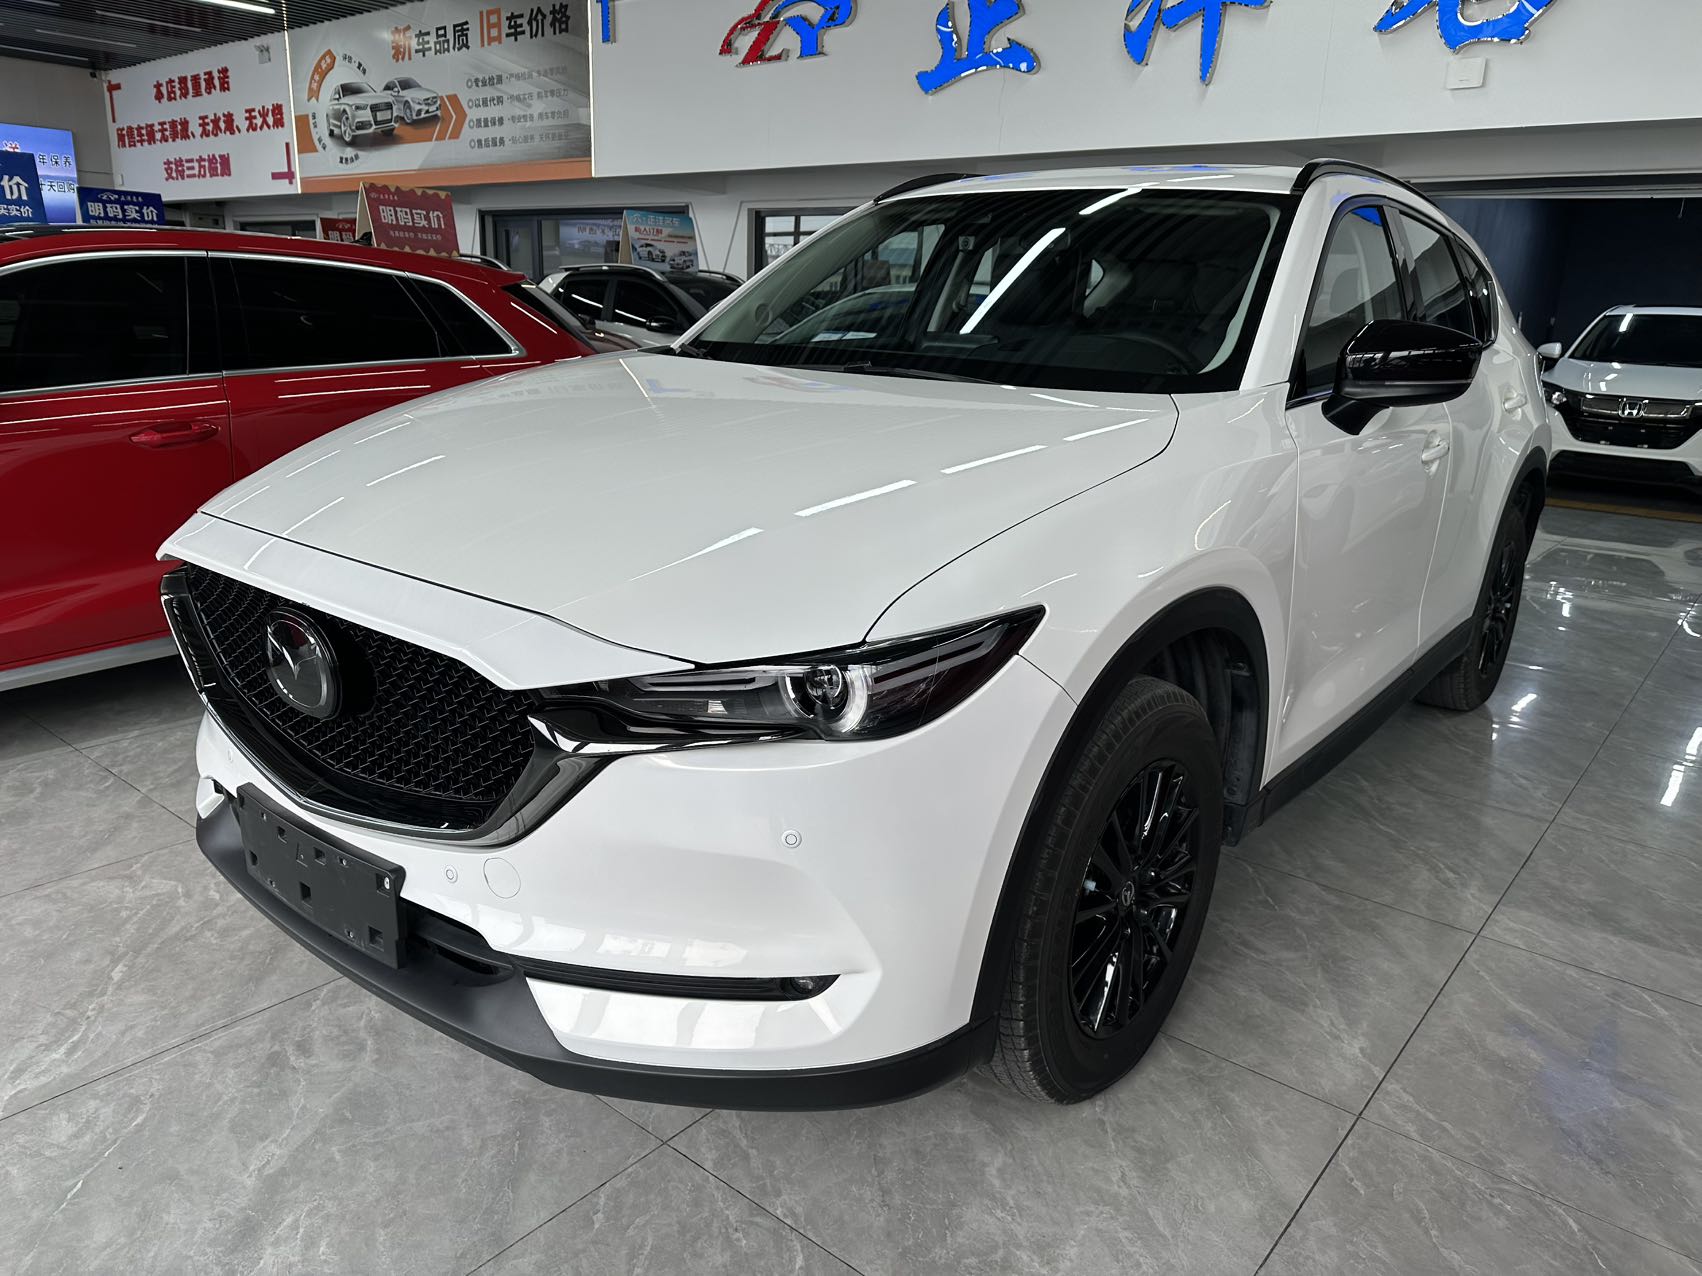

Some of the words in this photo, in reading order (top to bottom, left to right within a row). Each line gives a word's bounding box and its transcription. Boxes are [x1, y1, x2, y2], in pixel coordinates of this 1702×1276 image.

[391, 20, 471, 63] 新车品质
[480, 3, 571, 48] 旧车价格
[153, 66, 231, 103] 本店郑重承诺
[474, 74, 503, 88] 专业检测
[474, 95, 504, 108] 以租代购
[476, 136, 505, 149] 售后服务
[38, 154, 72, 168] 年保养
[163, 153, 231, 181] 支持三方检测
[0, 175, 29, 200] 价
[87, 201, 158, 221] 明码实价
[379, 205, 445, 229] 明码实价
